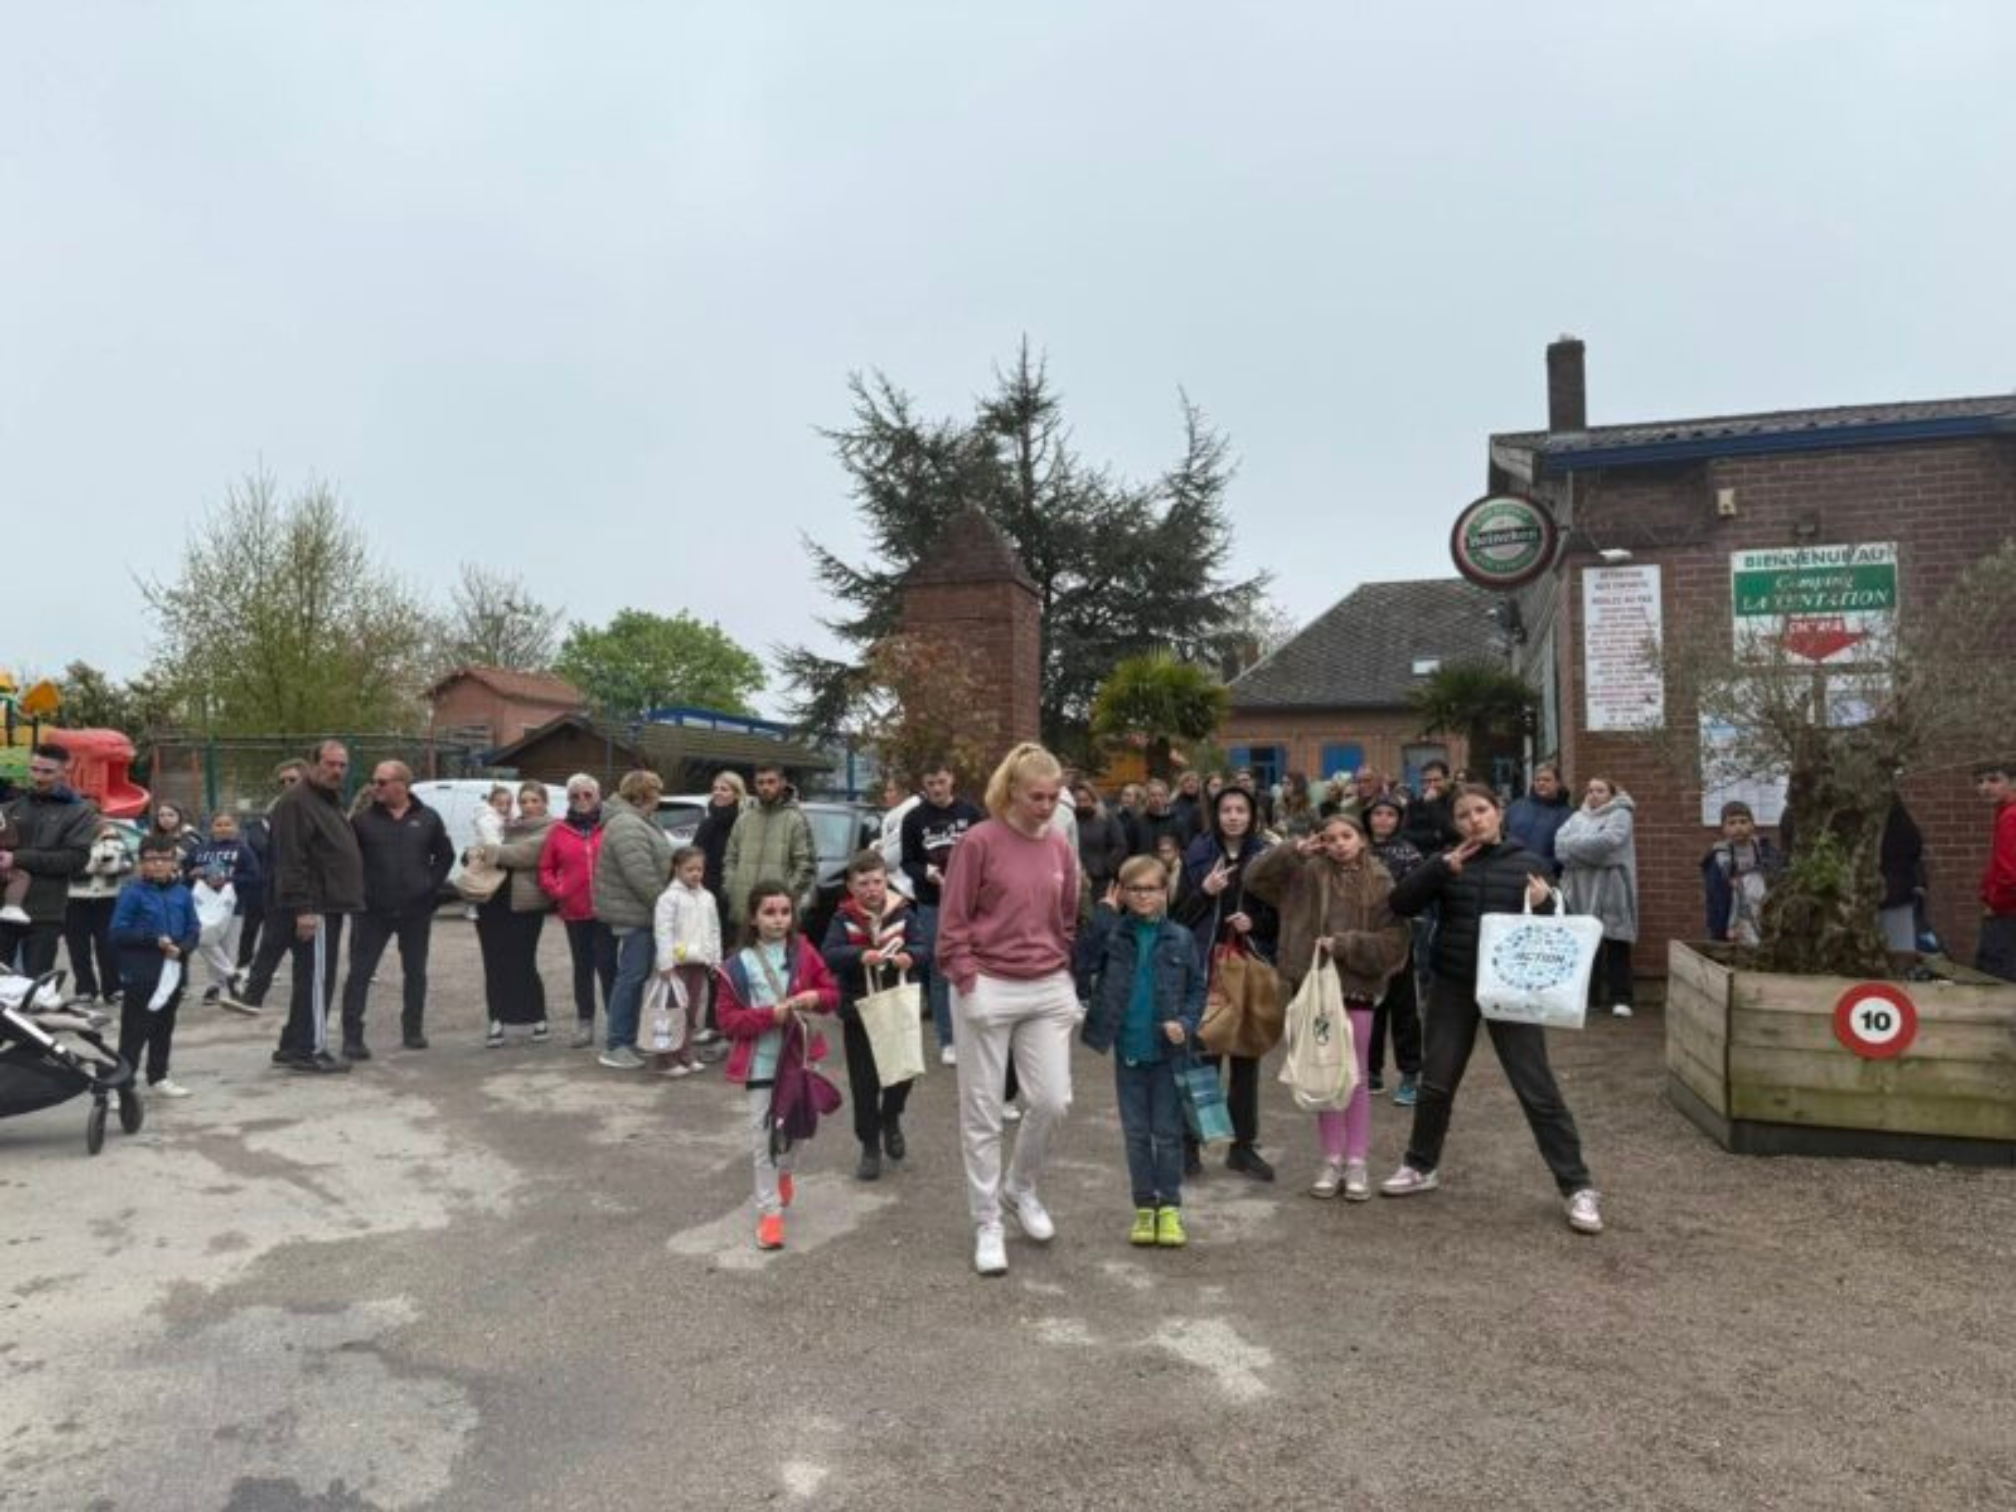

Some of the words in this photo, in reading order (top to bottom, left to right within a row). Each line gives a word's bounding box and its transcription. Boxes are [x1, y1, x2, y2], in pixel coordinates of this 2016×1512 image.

[1744, 549, 1852, 568] BIENVENUE
[1857, 548, 1883, 561] AU
[1743, 596, 1767, 610] LA
[1514, 952, 1565, 963] ACTION
[1861, 1010, 1891, 1031] 10
